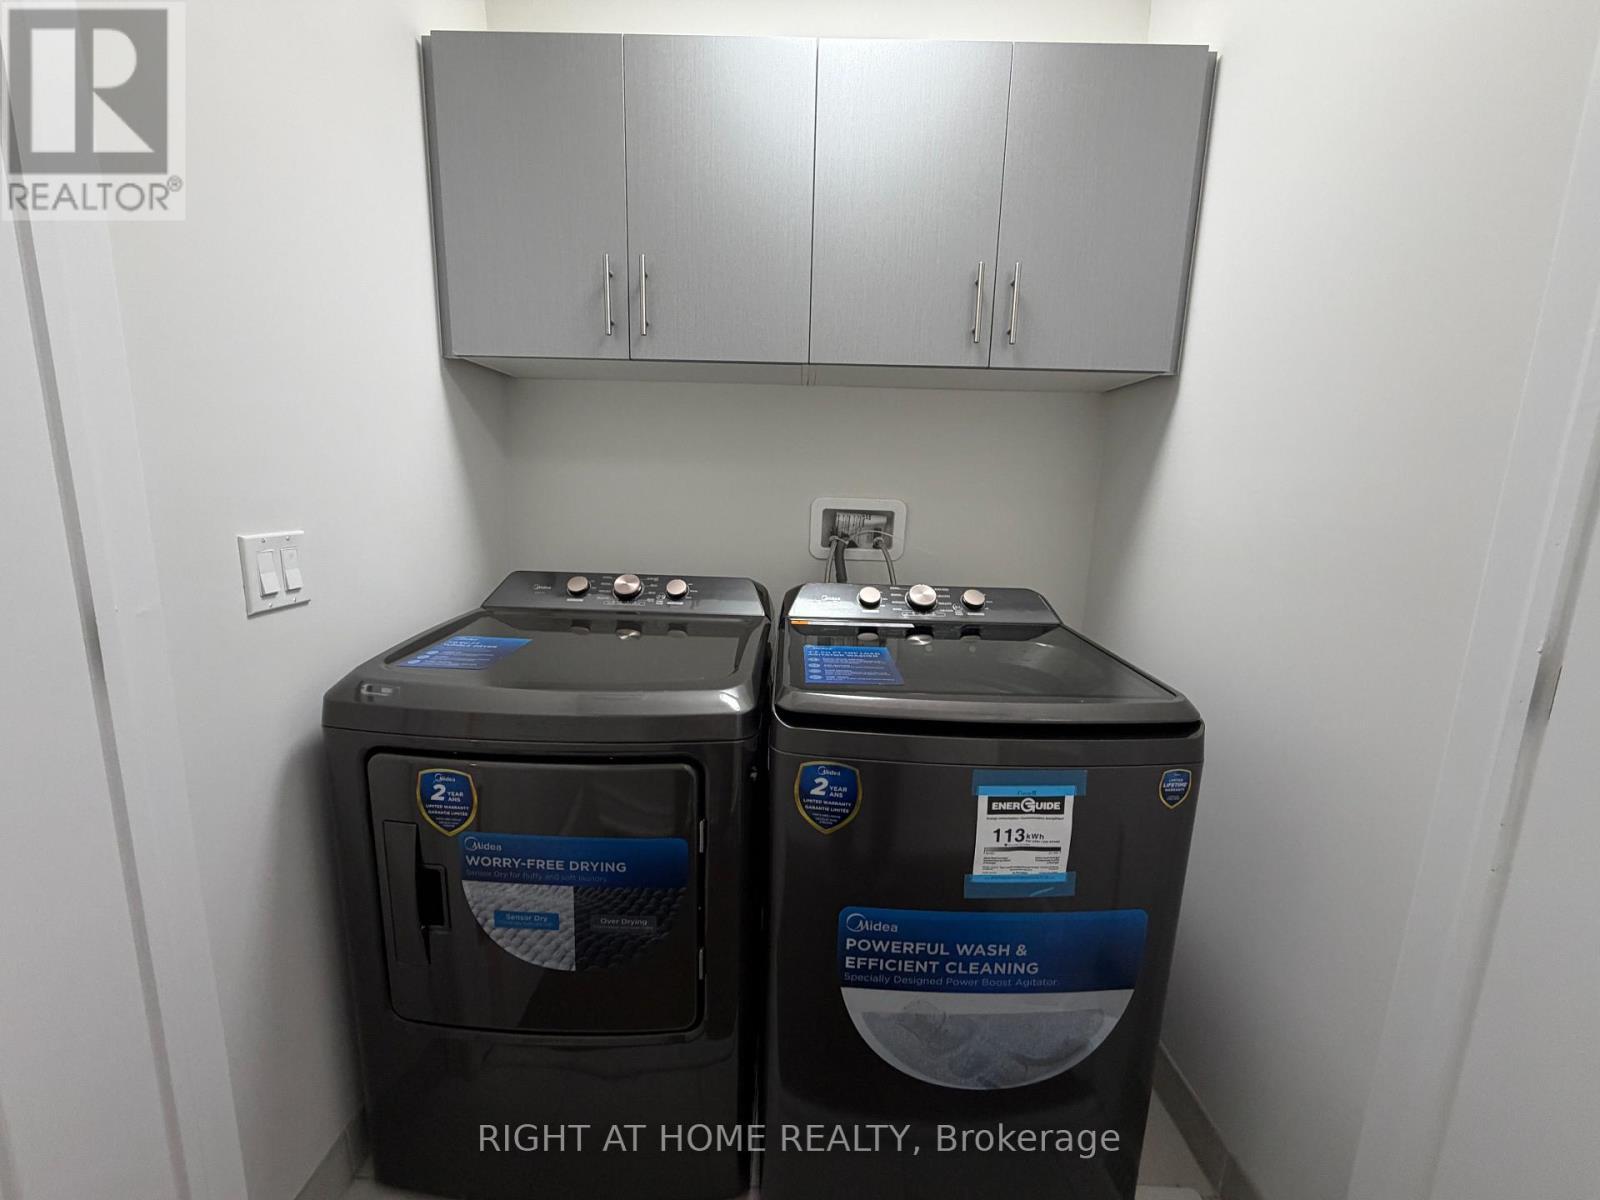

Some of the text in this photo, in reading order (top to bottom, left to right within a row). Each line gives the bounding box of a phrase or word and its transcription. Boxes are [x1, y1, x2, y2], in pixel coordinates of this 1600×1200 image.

[816, 765, 841, 776] Midea
[430, 784, 446, 801] 2
[810, 777, 829, 796] 2
[991, 797, 1061, 813] ENERGUIDE
[464, 836, 502, 851] Midea
[993, 828, 1026, 843] 113
[465, 855, 627, 873] WORRY-FREE DRYING
[505, 912, 548, 922] Sensor Dry
[600, 917, 619, 925] Over
[621, 918, 648, 927] Drying
[846, 913, 898, 933] Midea
[845, 938, 1028, 957] POWERFUL WASH &
[844, 956, 1039, 975] EFFICIENT CLEANING
[843, 972, 1057, 988] Specially Designed Power Boost Agitator
